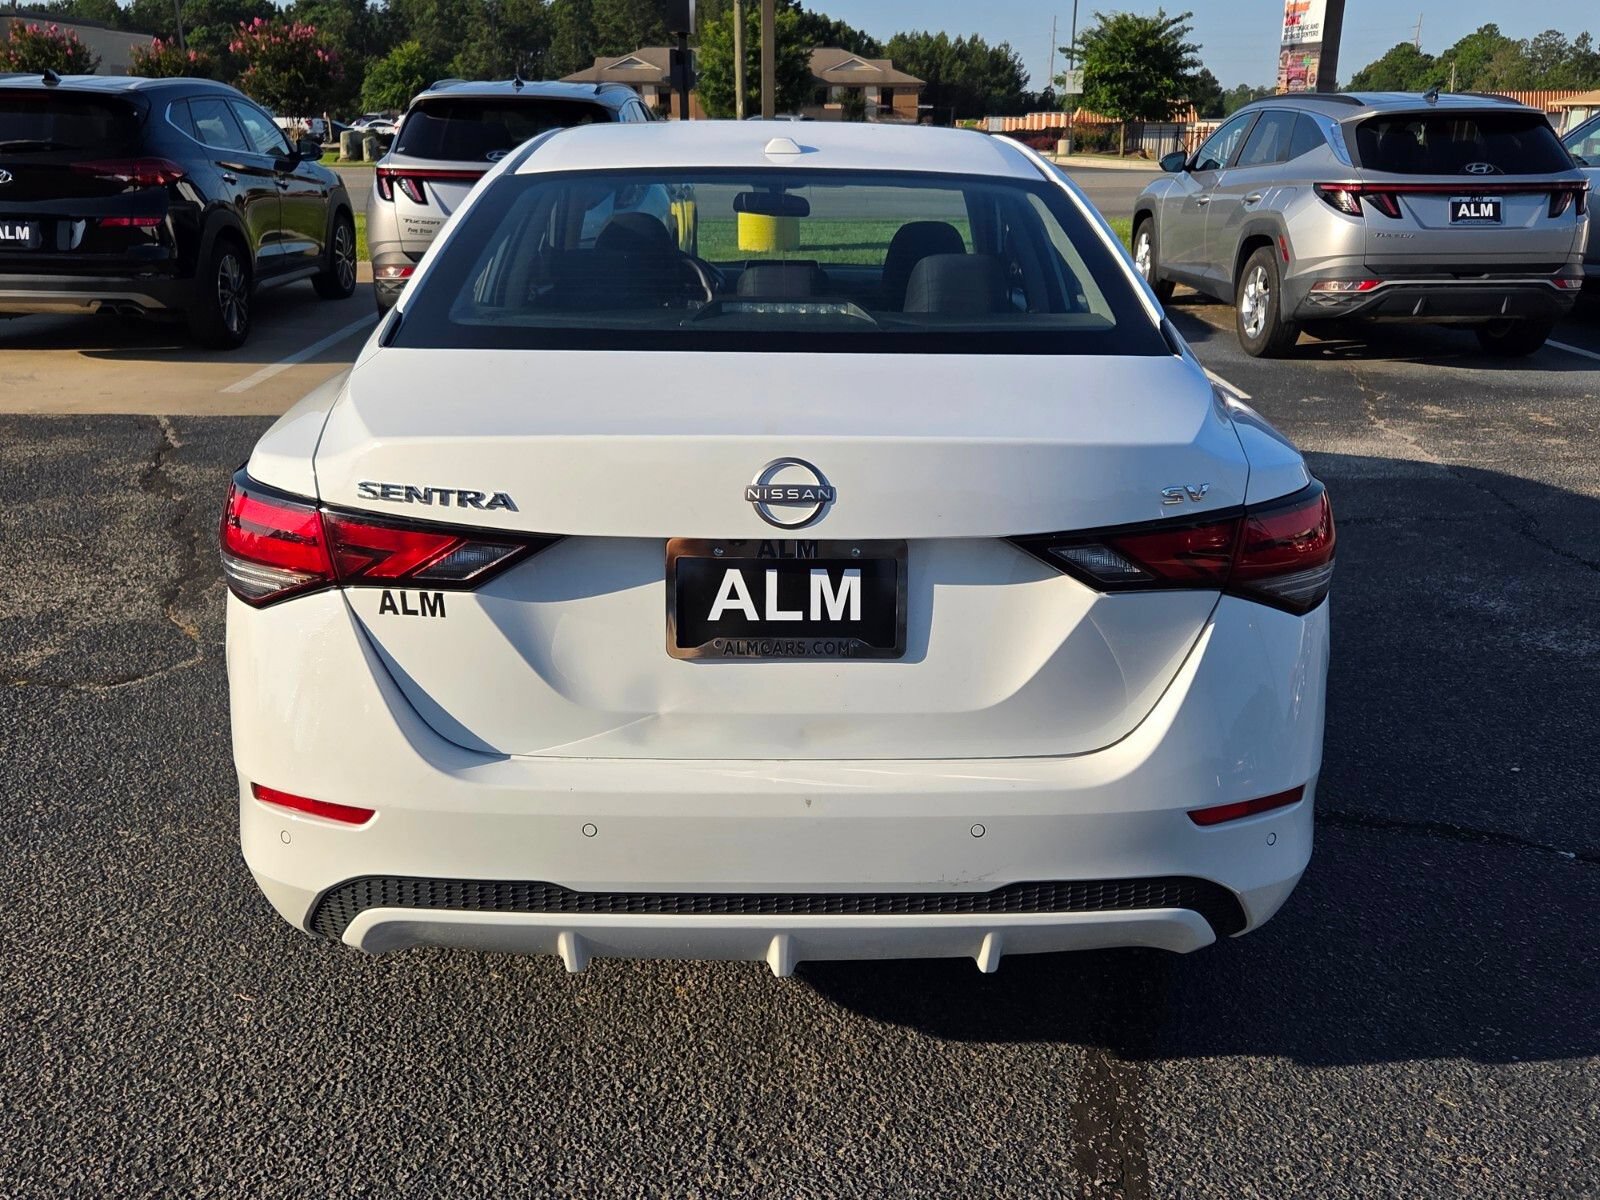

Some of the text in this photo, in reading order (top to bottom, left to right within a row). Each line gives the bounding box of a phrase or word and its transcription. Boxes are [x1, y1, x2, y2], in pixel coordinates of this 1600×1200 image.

[1457, 203, 1494, 217] ALM
[357, 481, 520, 512] SENTRA
[747, 488, 831, 500] NISSAN
[1160, 482, 1210, 505] SV
[755, 539, 819, 559] ALM
[378, 589, 447, 618] ALM
[707, 568, 862, 621] ALM
[722, 639, 850, 657] ALMCARS.COM
